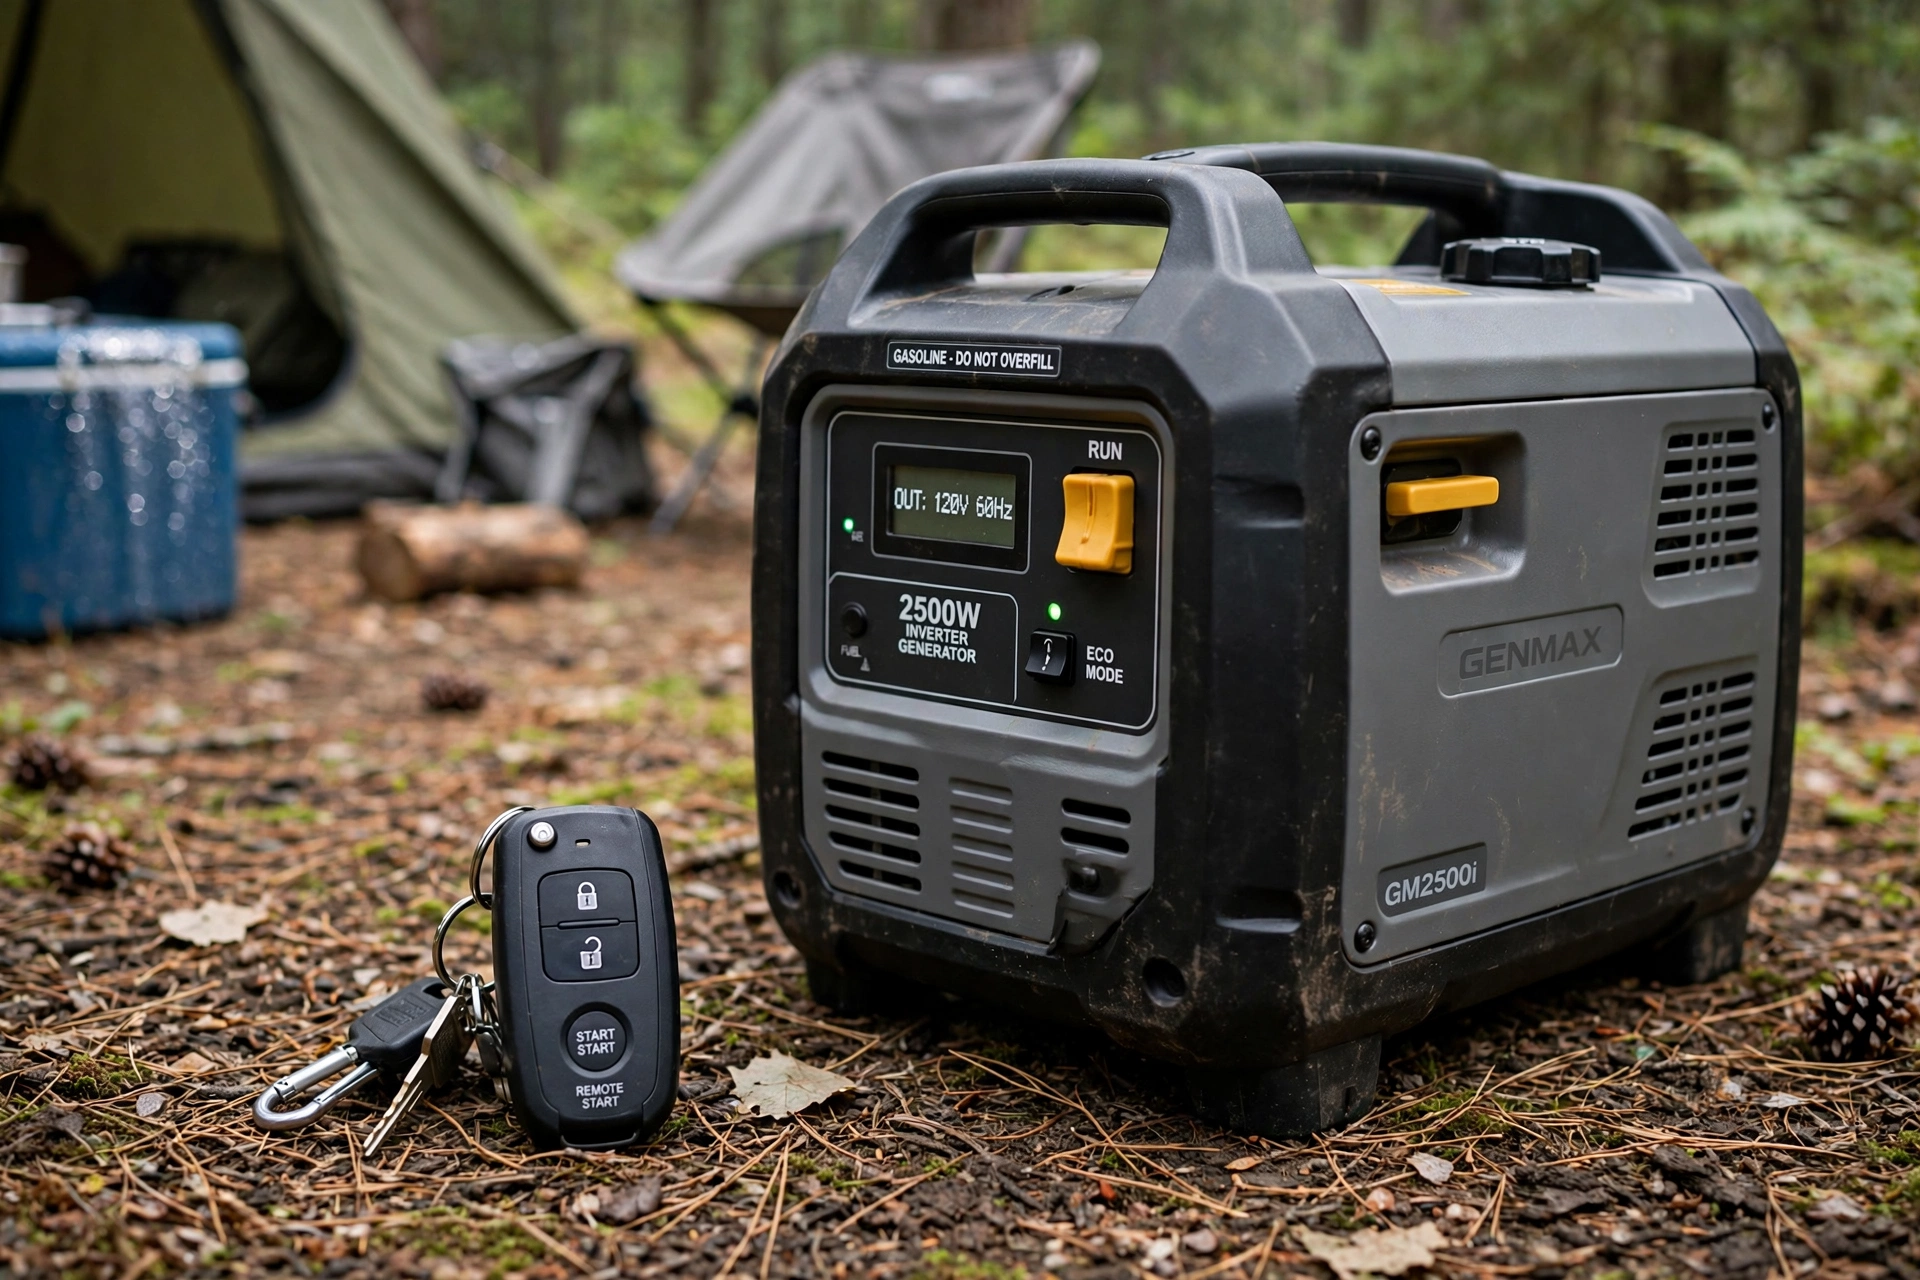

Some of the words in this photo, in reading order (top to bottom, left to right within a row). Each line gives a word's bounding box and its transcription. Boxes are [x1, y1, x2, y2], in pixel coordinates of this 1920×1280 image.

[893, 348, 947, 365] GASOLINE
[955, 350, 971, 366] DO
[974, 351, 998, 367] NOT
[1000, 352, 1054, 370] OVERFILL
[1088, 440, 1123, 461] RUN
[894, 487, 926, 511] OUT:
[934, 491, 970, 516] 120V
[976, 495, 1013, 521] 60Hz
[898, 594, 981, 629] 2500W
[906, 623, 969, 646] INVERTER
[898, 638, 977, 664] GENERATOR
[1086, 646, 1114, 664] ECO
[1459, 626, 1602, 680] GENMAX
[1085, 665, 1124, 685] MODE
[1384, 861, 1477, 906] GM2500i
[576, 1028, 615, 1042] START
[577, 1042, 615, 1056] START
[576, 1082, 624, 1097] REMOTE
[582, 1096, 620, 1109] START
